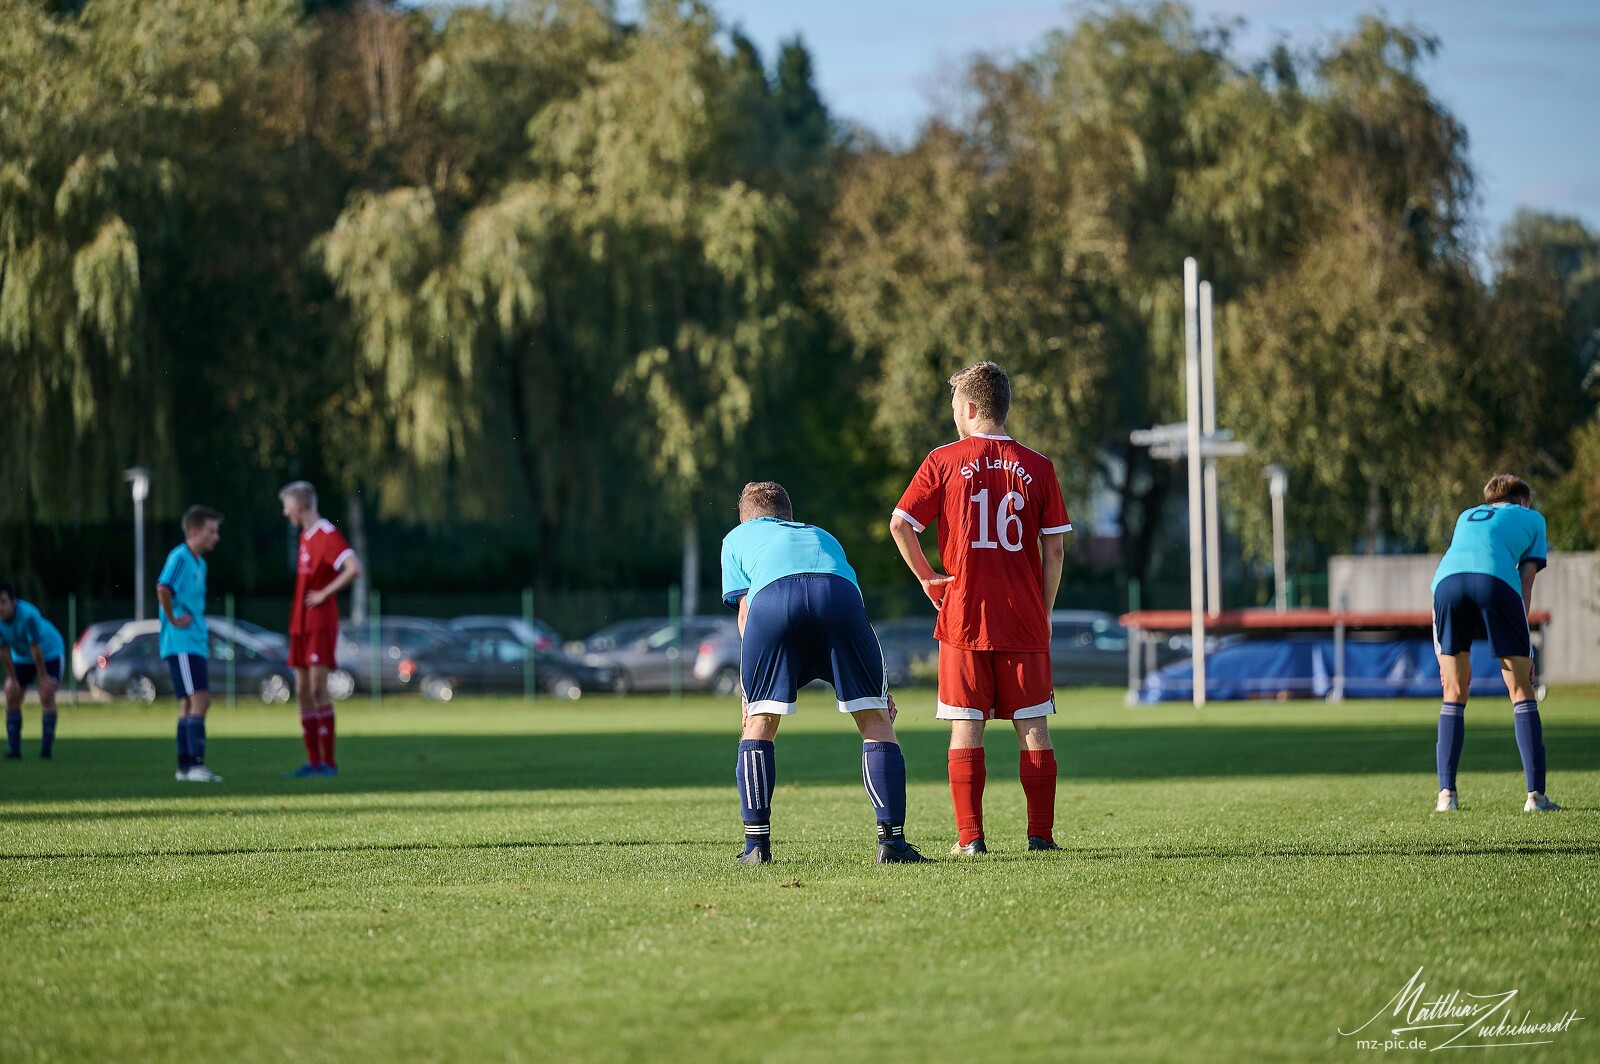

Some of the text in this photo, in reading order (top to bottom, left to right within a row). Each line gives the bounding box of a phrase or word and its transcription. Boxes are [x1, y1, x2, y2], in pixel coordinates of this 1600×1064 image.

[960, 456, 1033, 485] SV Laufen
[970, 488, 1025, 552] 16
